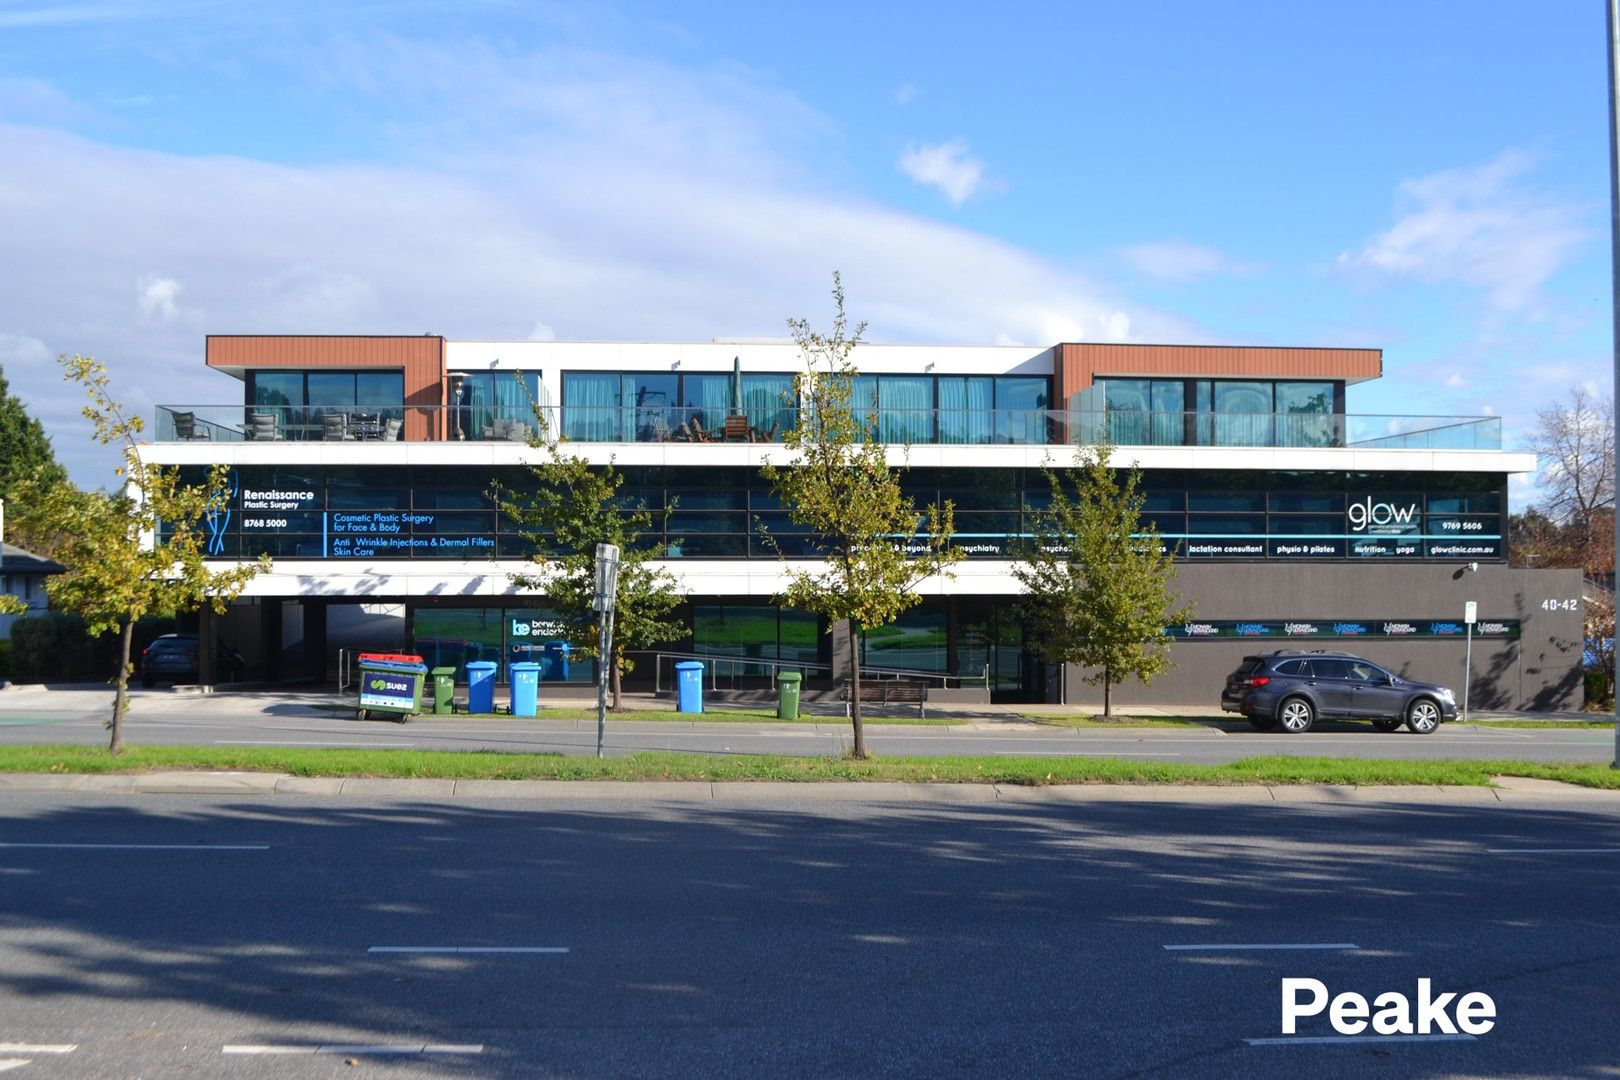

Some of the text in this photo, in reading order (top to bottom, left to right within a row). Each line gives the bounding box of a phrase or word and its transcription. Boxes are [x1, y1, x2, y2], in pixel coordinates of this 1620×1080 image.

[244, 490, 314, 500] Renaissance
[244, 501, 299, 510] Plastic Surgery
[1348, 495, 1416, 531] glow
[244, 519, 287, 527] 8768 5000
[333, 513, 434, 524] Cosmetic Plastic Surgery
[333, 523, 401, 534] for Face & Body
[1442, 522, 1482, 530] 9769 5606
[355, 538, 388, 547] Wrinkle
[390, 538, 428, 549] Injections
[430, 538, 437, 547] &
[439, 537, 469, 547] Dermal
[471, 537, 495, 547] Fillers
[333, 548, 375, 557] Skin Care
[1189, 545, 1263, 553] lactation consultant
[1276, 545, 1302, 554] physio
[1310, 545, 1335, 554] pilates
[1430, 546, 1494, 554] glowclinic.com.au
[1541, 599, 1578, 611] 40-42
[385, 682, 408, 691] suez
